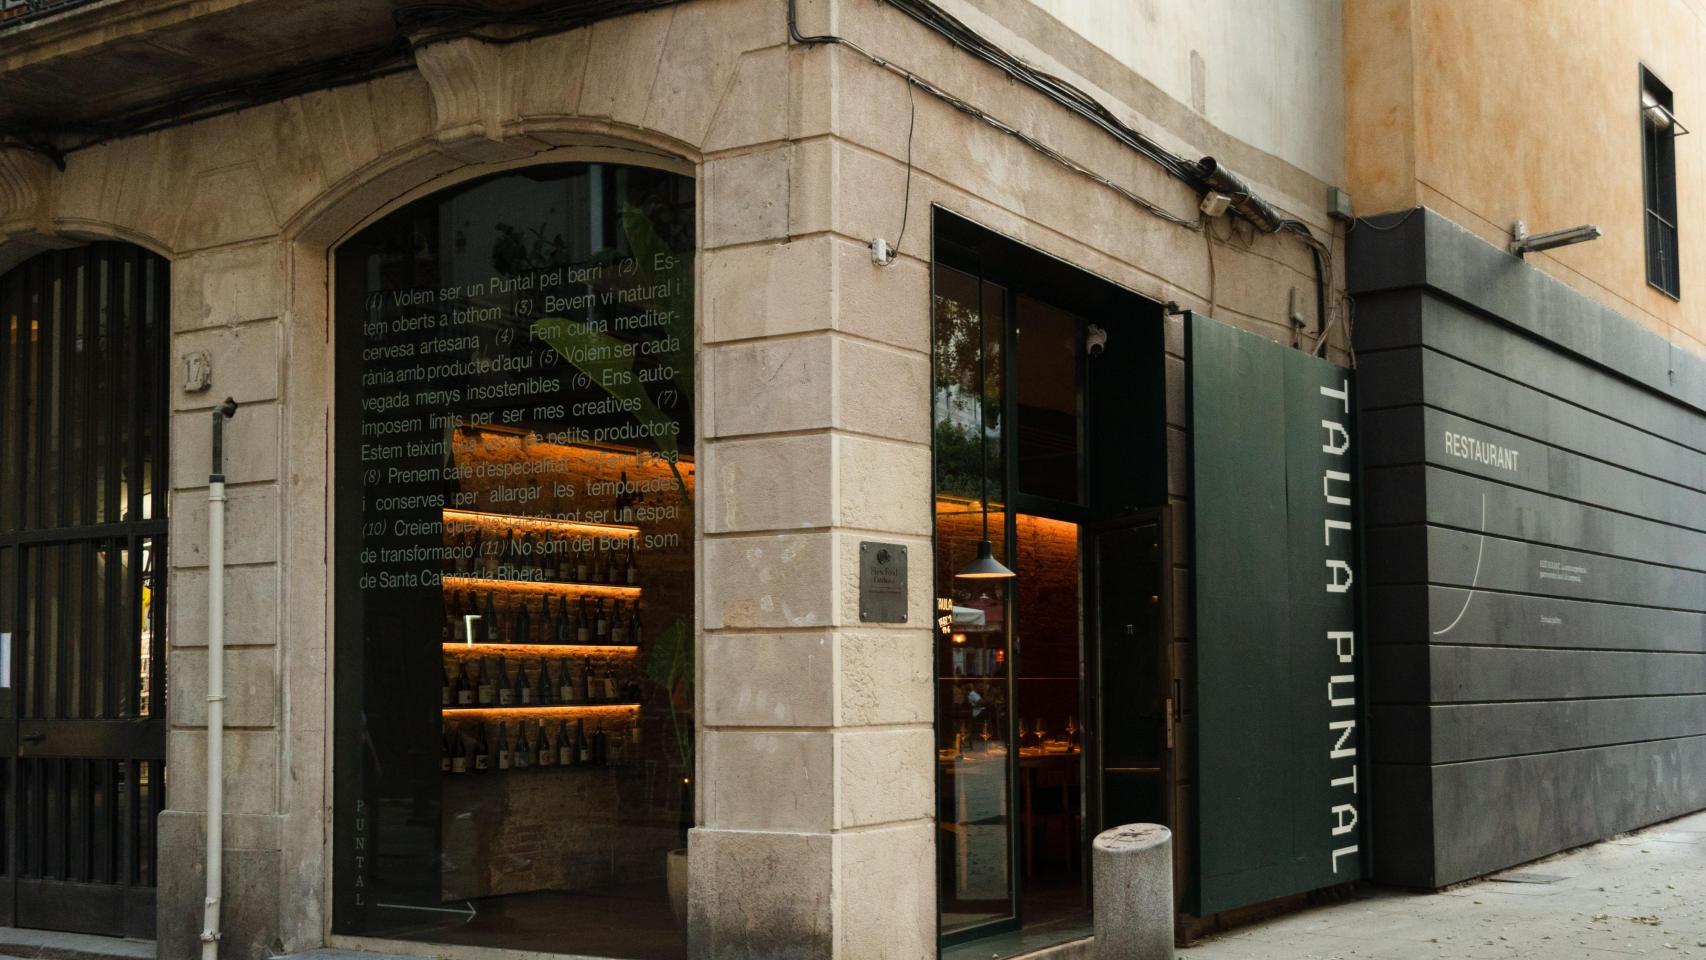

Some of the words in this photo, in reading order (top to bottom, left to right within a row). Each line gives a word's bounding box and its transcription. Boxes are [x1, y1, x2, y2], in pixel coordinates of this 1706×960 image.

[393, 288, 434, 307] Volem
[439, 286, 461, 301] ser
[467, 283, 484, 298] un
[490, 271, 534, 294] Puntal
[540, 268, 562, 291] pel
[568, 262, 602, 284] barri
[618, 257, 639, 278] (2)
[654, 252, 680, 272] Es-
[363, 320, 388, 337] tem
[392, 314, 436, 333] oberts
[439, 314, 448, 327] a
[453, 306, 502, 325] tothom
[514, 299, 533, 317] (3)
[545, 293, 596, 313] Bevem
[600, 287, 613, 305] vi
[618, 279, 671, 304] natural
[676, 278, 681, 296] i
[362, 342, 414, 361] cervesa
[420, 335, 480, 355] artesana
[495, 327, 515, 346] (4)
[529, 323, 561, 342] Fem
[567, 317, 608, 337] cuina
[615, 309, 681, 331] mediter-
[396, 363, 425, 382] amb
[427, 360, 489, 382] producte
[539, 349, 559, 367] (5)
[565, 343, 611, 363] Volem
[614, 341, 639, 359] ser
[641, 335, 680, 355] cada
[361, 391, 410, 413] vegada
[415, 388, 461, 407] menys
[467, 376, 560, 401] insostenibles
[571, 371, 592, 391] (6)
[602, 368, 632, 387] Ens
[638, 363, 680, 383] auto-
[361, 417, 422, 438] imposem
[471, 411, 495, 428] per
[502, 408, 525, 424] ser
[572, 396, 642, 418] creatives
[657, 390, 678, 409] (7)
[361, 444, 403, 461] Estem
[407, 439, 449, 457] teixint
[547, 426, 590, 446] petits
[594, 420, 681, 445] productors
[1445, 431, 1519, 472] RESTAURANT
[362, 495, 366, 512] i
[375, 492, 445, 511] conserves
[455, 491, 479, 509] per
[490, 485, 542, 504] allargar
[553, 481, 576, 498] les
[586, 475, 680, 499] temporades
[363, 468, 381, 487] (8)
[388, 466, 439, 484] Prenem
[476, 456, 569, 480] d'especialitat
[1320, 379, 1353, 592] TAULA
[362, 519, 387, 539] (10)
[394, 518, 443, 537] Creiem
[446, 520, 473, 537] que
[556, 507, 581, 526] pot
[584, 508, 609, 524] ser
[613, 506, 632, 523] un
[636, 501, 679, 524] espai
[360, 547, 377, 564] de
[479, 539, 505, 559] (11)
[510, 538, 532, 556] No
[535, 537, 568, 555] som
[571, 535, 595, 553] del
[644, 532, 679, 549] som
[359, 573, 377, 590] de
[379, 570, 418, 589] Santa
[420, 568, 479, 587] Caterina
[482, 565, 494, 584] la
[497, 564, 547, 582] Ribera.
[1327, 631, 1358, 873] PUNTAL
